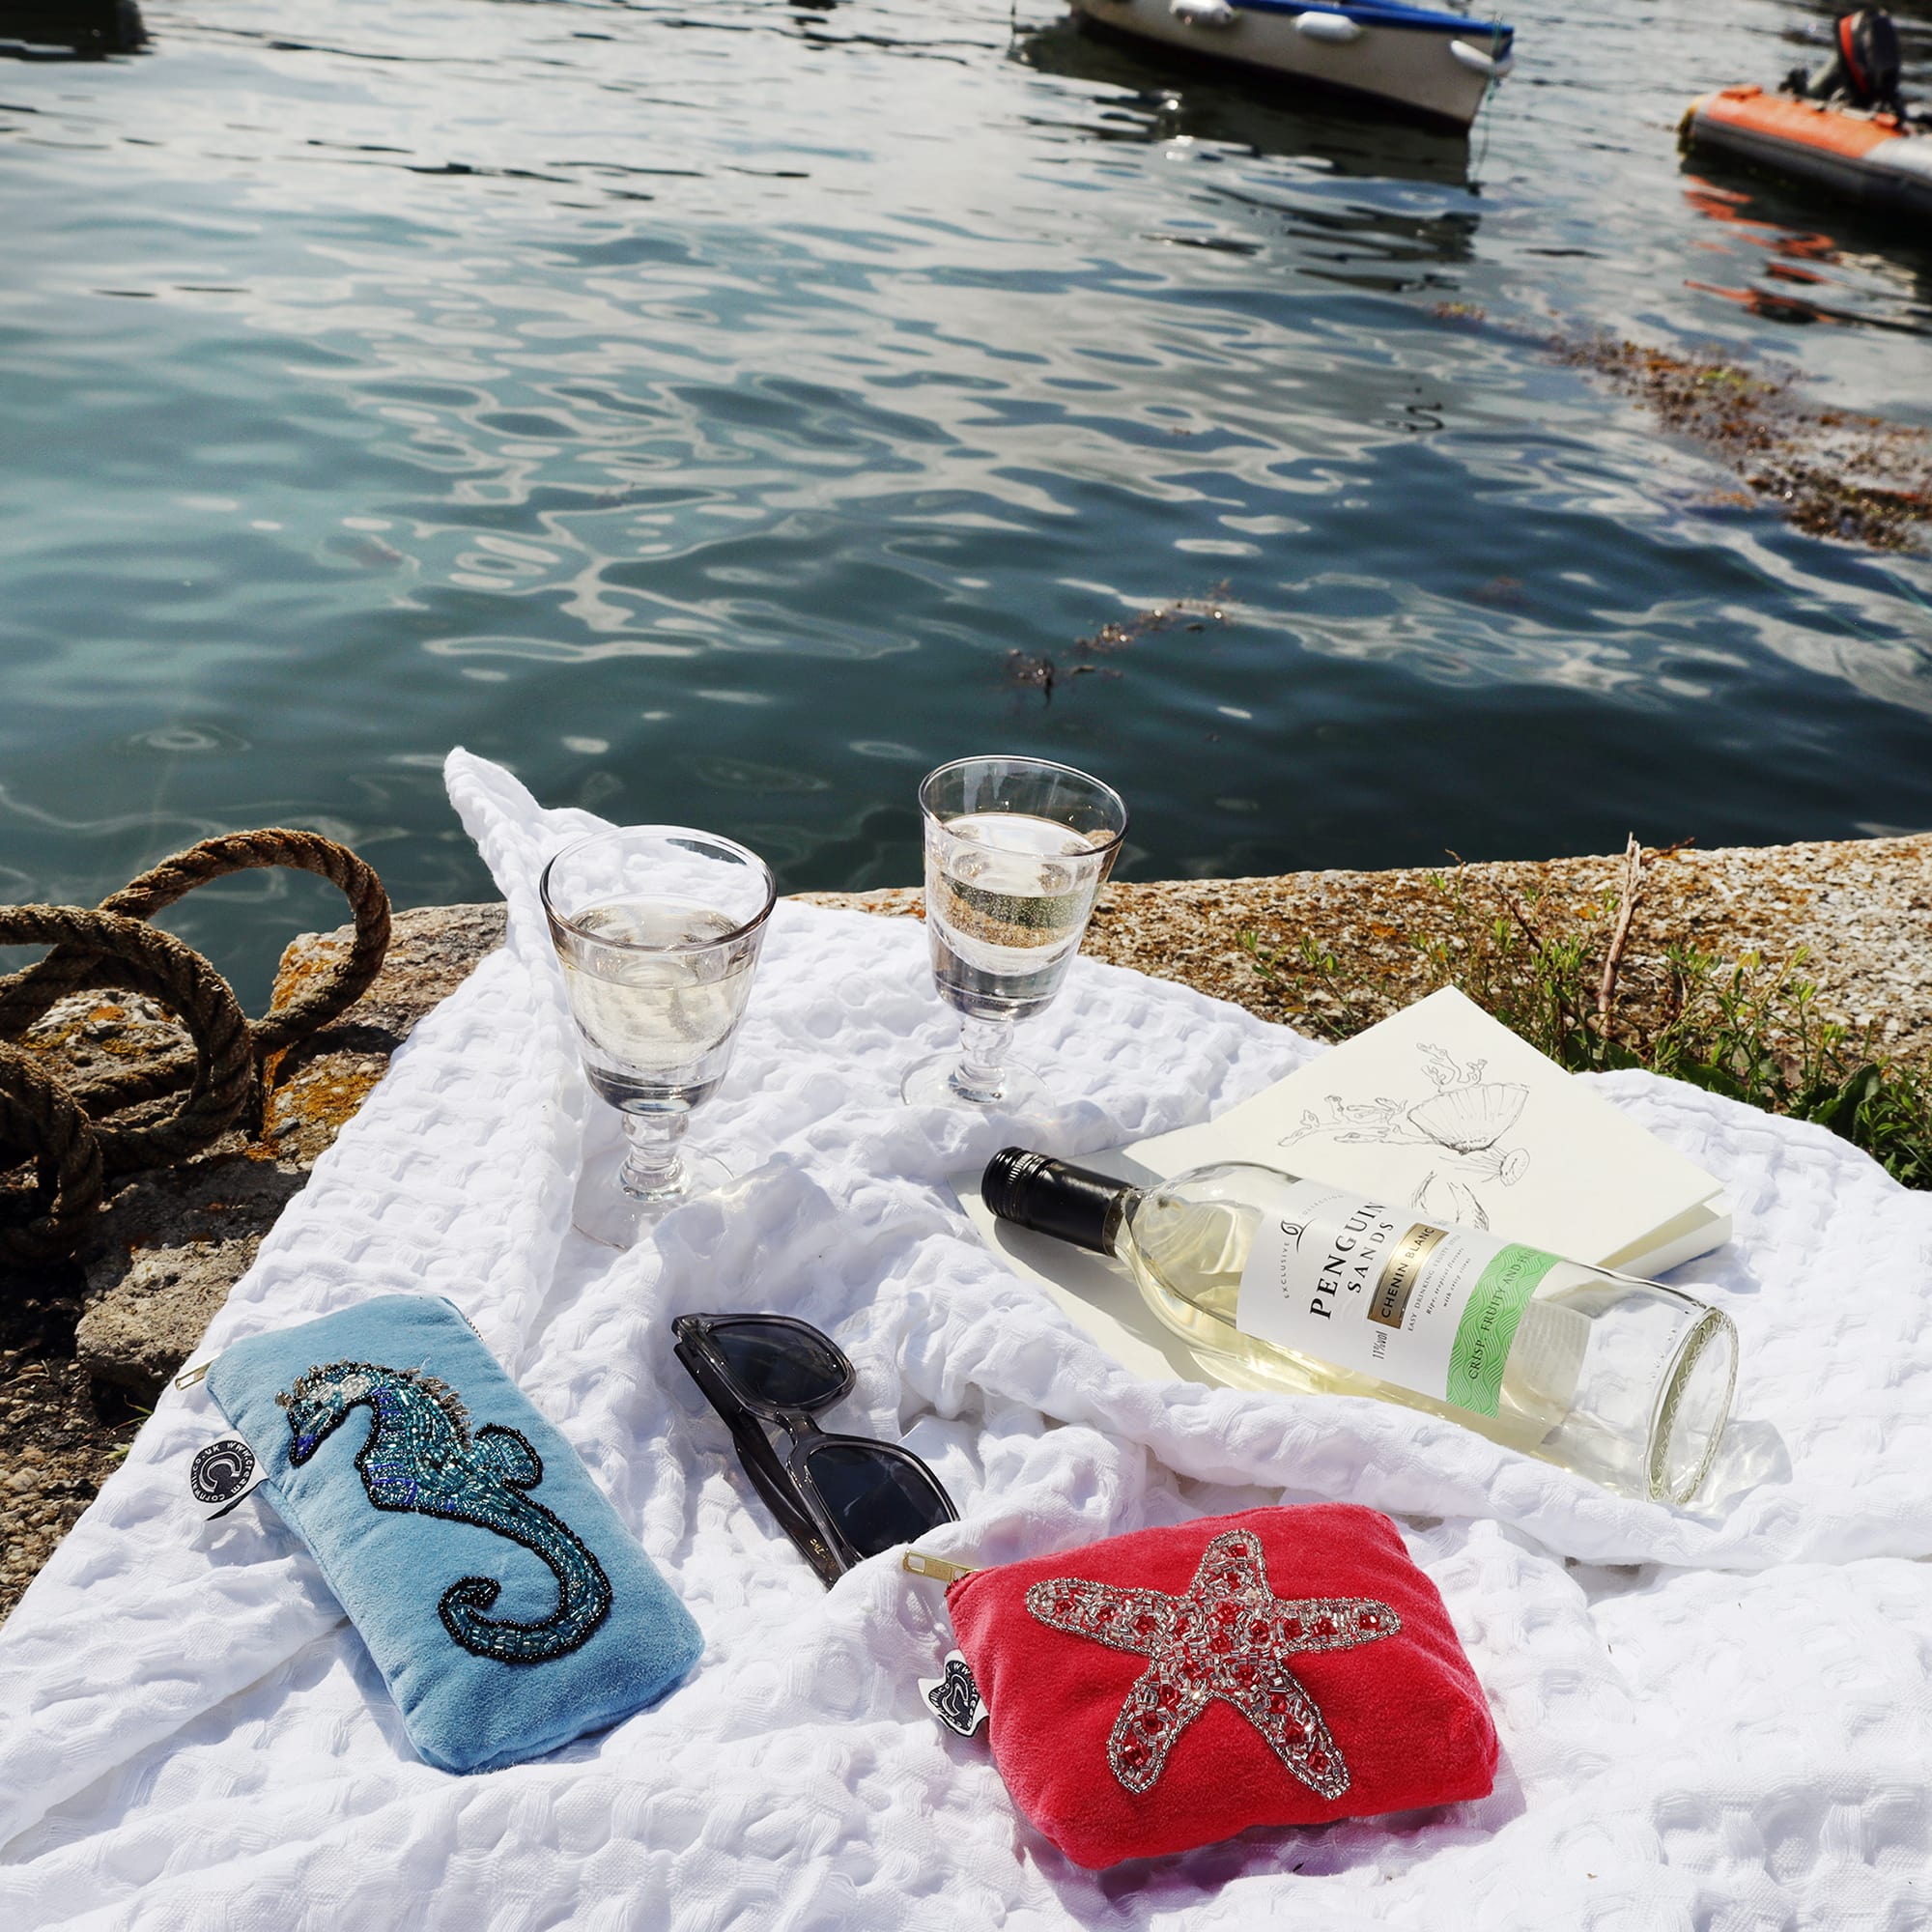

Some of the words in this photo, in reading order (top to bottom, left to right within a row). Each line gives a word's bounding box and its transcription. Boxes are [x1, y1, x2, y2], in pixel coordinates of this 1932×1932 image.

[1280, 1241, 1291, 1299] EXCLUSIVE
[1309, 1201, 1386, 1321] PENGUIN
[1347, 1222, 1394, 1293] SANDS
[1381, 1262, 1409, 1320] CHENIN
[1406, 1227, 1435, 1259] BLANC
[1407, 1312, 1417, 1331] EASY
[1413, 1269, 1435, 1309] DRINKING
[1441, 1292, 1452, 1307] with
[1480, 1286, 1506, 1332] FRUITY
[1502, 1264, 1522, 1285] AND
